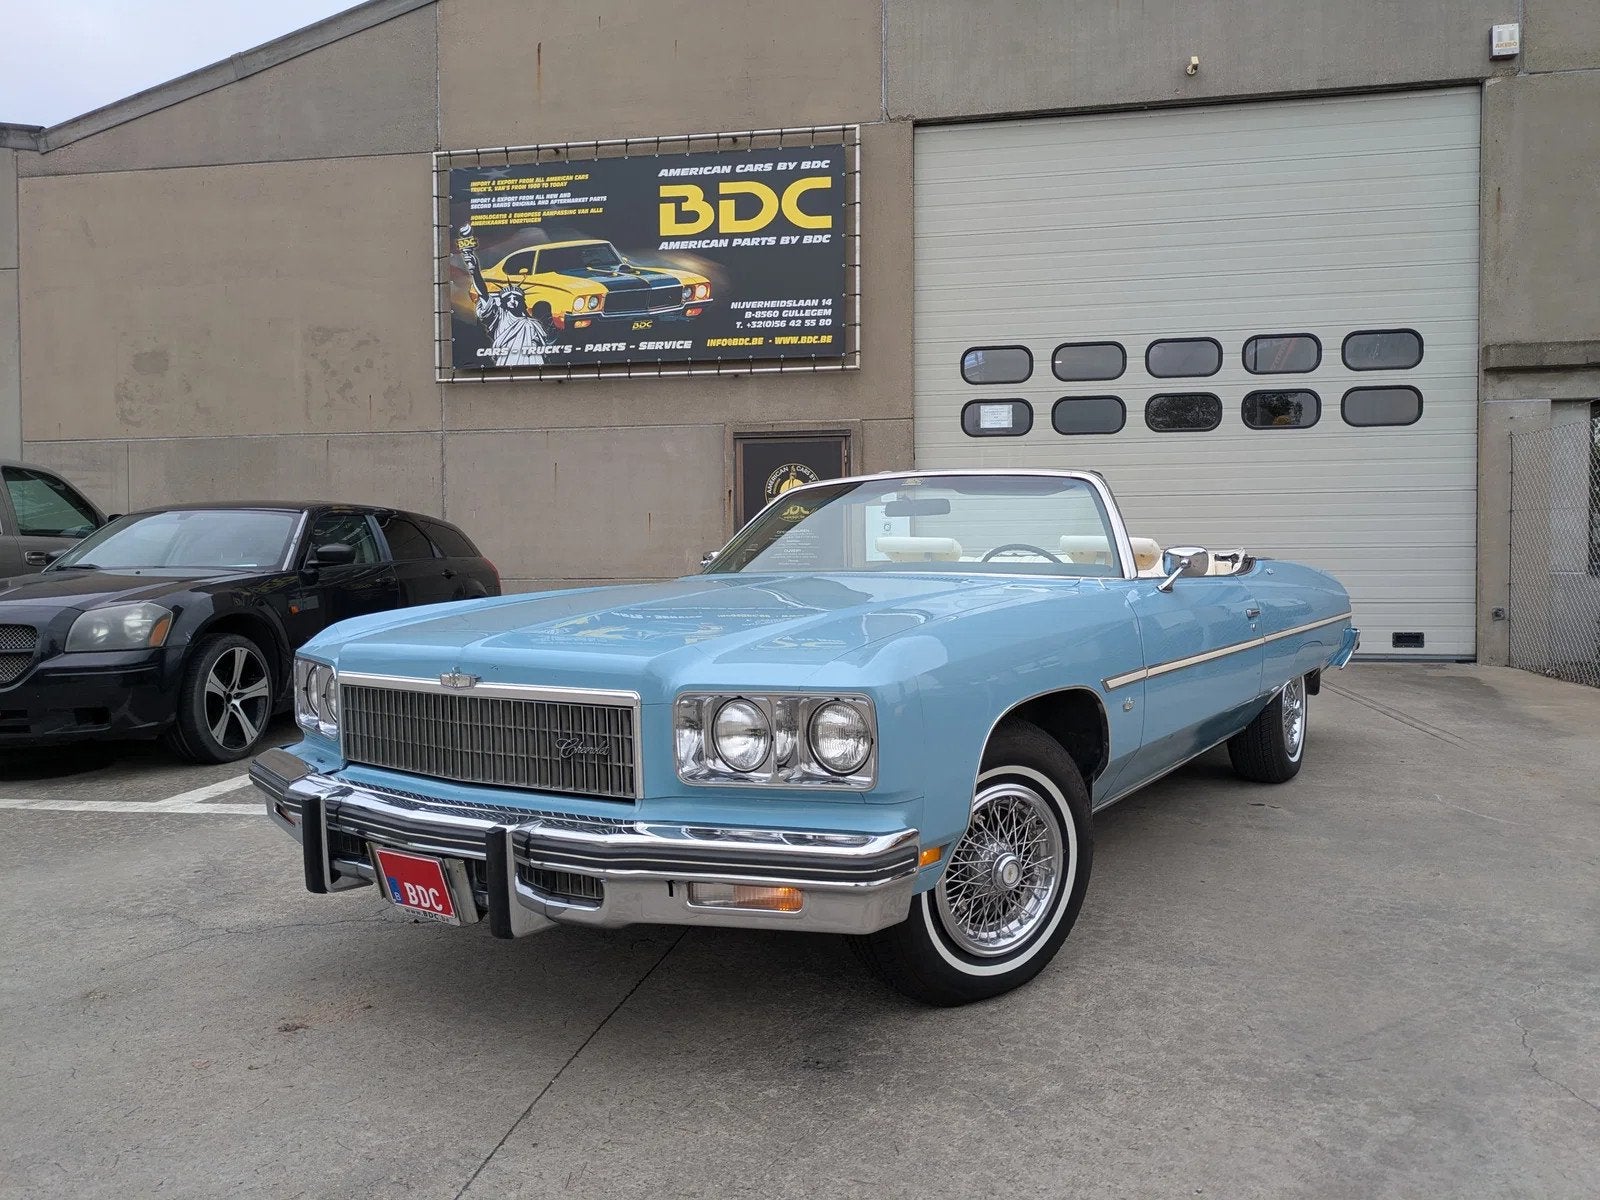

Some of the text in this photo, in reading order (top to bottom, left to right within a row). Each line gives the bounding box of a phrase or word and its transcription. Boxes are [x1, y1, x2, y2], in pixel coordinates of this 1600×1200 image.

[658, 159, 831, 177] AMERICAN CARS BY BDC
[550, 197, 589, 205] AFTERMARKET
[659, 176, 832, 236] BDC
[658, 234, 832, 250] AMERICAN PARTS BY BDC
[730, 298, 833, 309] NIJVERHEIDSLAAN 14
[744, 308, 832, 319] B-8560 GULLEGEM
[735, 321, 743, 329] T.
[746, 320, 786, 329] +32(0)56
[789, 319, 802, 327] 42
[819, 318, 832, 326] 80
[774, 335, 833, 345] WWW.BDC.BE
[476, 347, 509, 357] CARS
[521, 344, 573, 355] TRUCK'S
[584, 342, 626, 352] PARTS
[638, 340, 693, 350] SERVICE
[766, 466, 789, 494] AMERICAN
[403, 882, 443, 911] BDC
